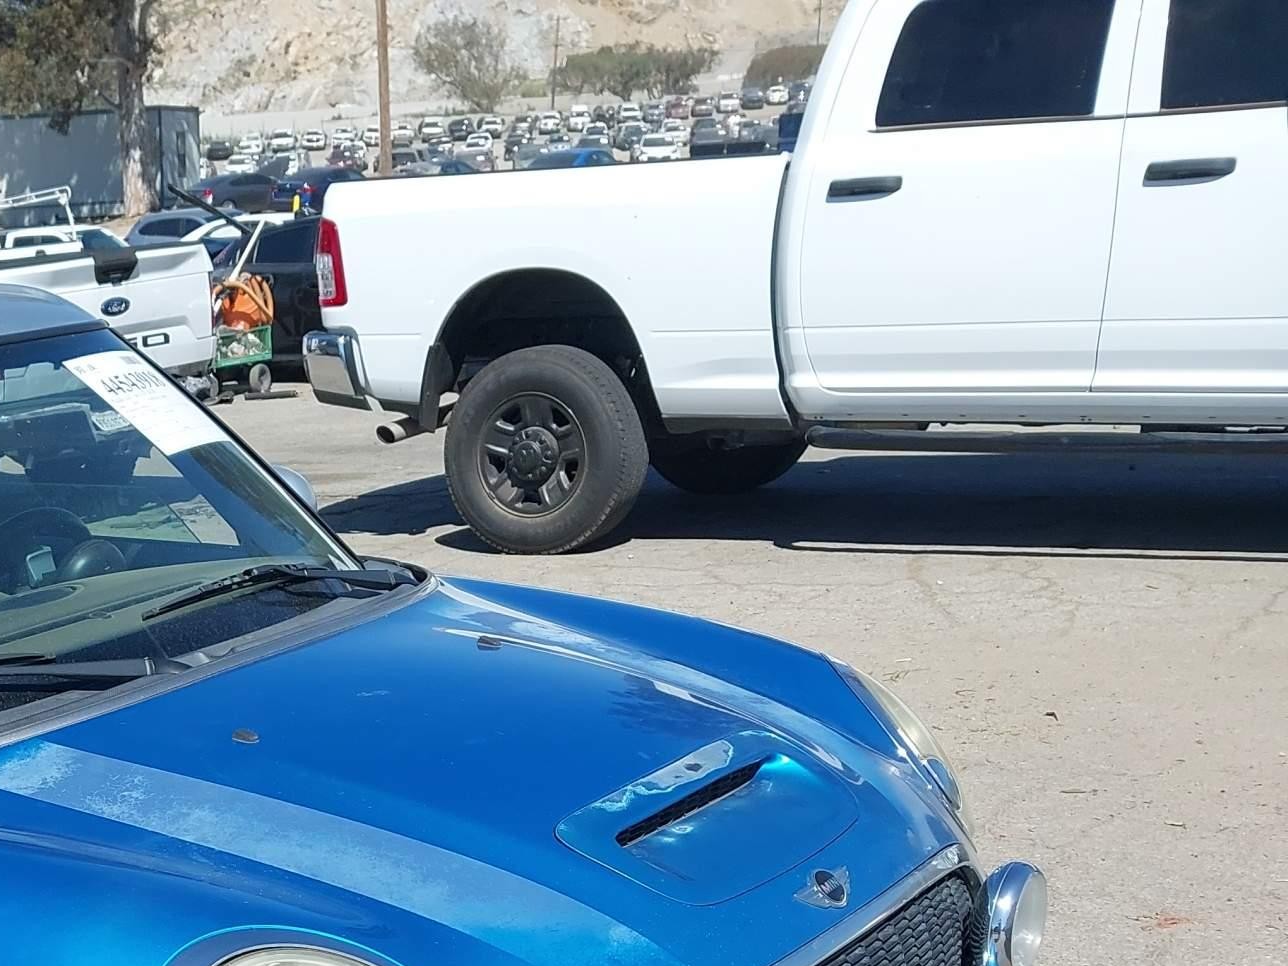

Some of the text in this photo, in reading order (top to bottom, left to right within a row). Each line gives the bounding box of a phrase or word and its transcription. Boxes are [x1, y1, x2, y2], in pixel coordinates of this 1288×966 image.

[103, 299, 128, 314] Ford
[100, 371, 166, 396] 44543918
[819, 877, 840, 894] MINI
